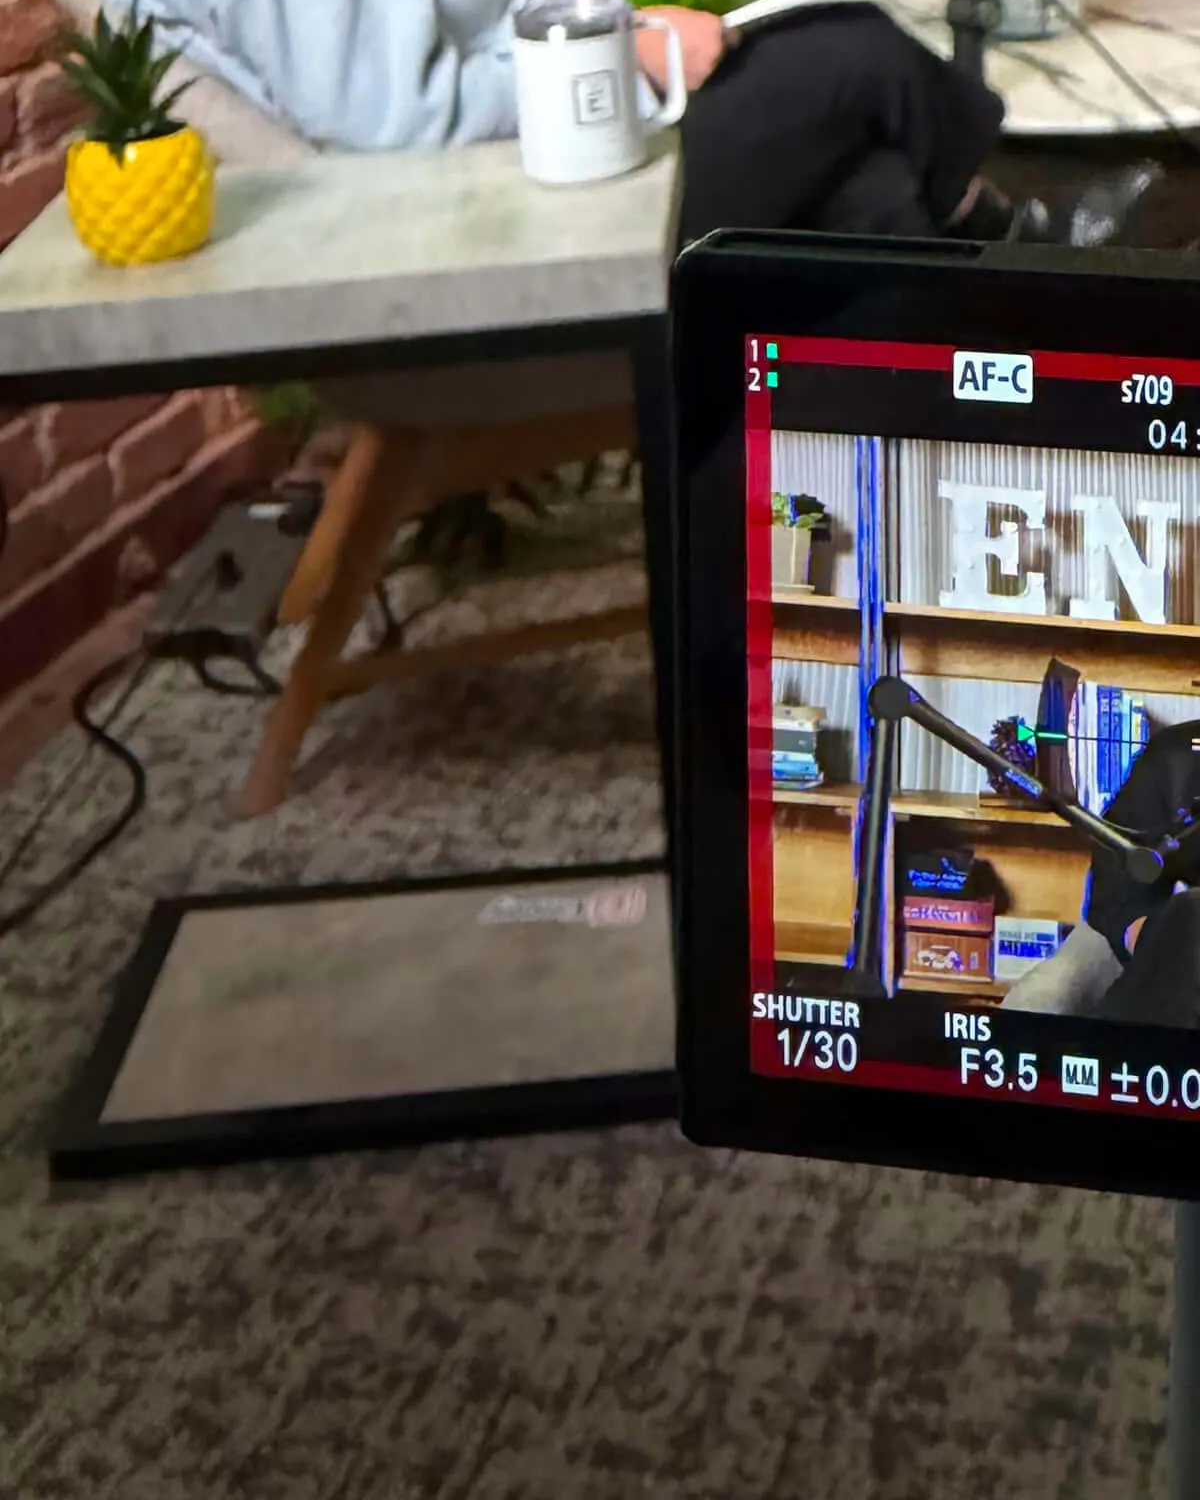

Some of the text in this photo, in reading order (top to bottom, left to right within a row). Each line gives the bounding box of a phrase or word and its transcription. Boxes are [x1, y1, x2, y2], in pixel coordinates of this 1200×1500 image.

[748, 367, 762, 391] 2
[958, 360, 1028, 394] AF-C
[1121, 374, 1173, 406] s709
[752, 991, 861, 1029] SHUTTER
[944, 1011, 992, 1043] IRIS
[777, 1028, 858, 1073] 1/30
[960, 1047, 1039, 1093] F3.5
